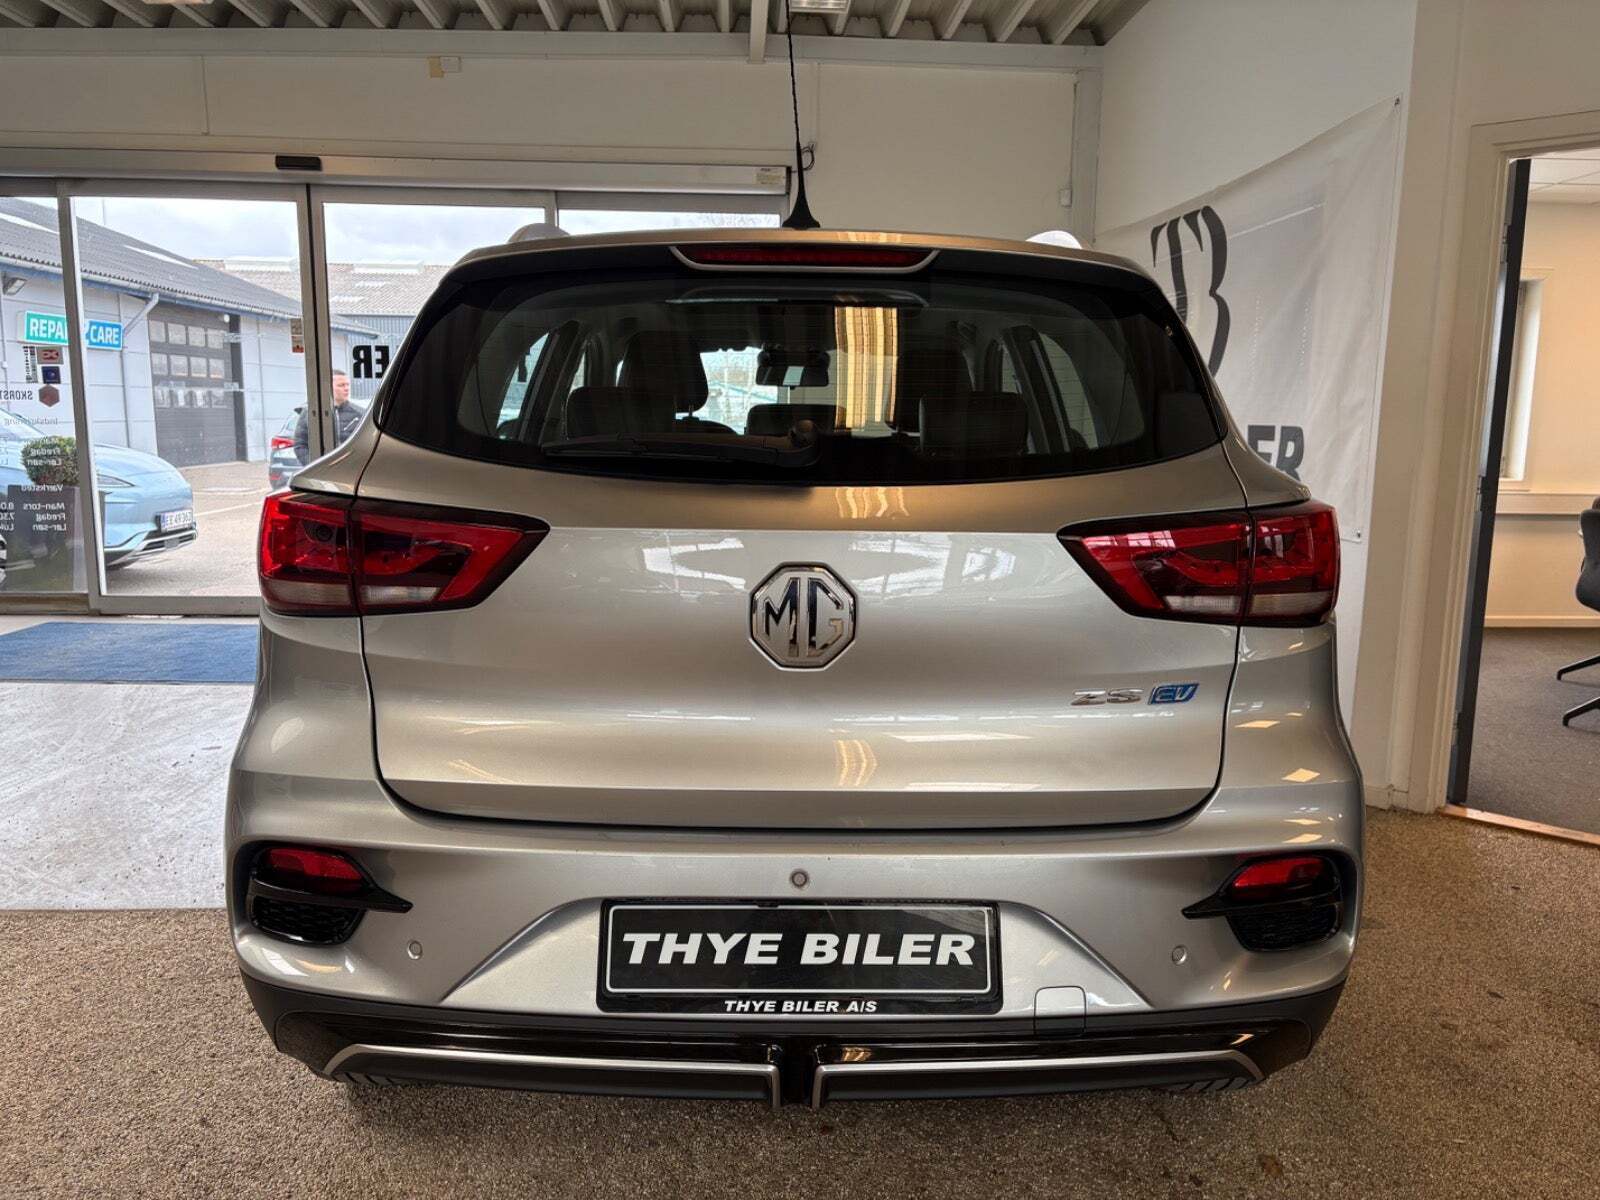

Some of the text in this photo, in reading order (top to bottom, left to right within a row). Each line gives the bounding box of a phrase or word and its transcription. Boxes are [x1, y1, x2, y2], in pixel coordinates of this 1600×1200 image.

[89, 325, 120, 345] CARE
[763, 576, 844, 658] MG
[1071, 685, 1196, 705] ZS EV
[622, 932, 976, 966] THYE BILER
[724, 1000, 878, 1013] THYE BILER A/S
